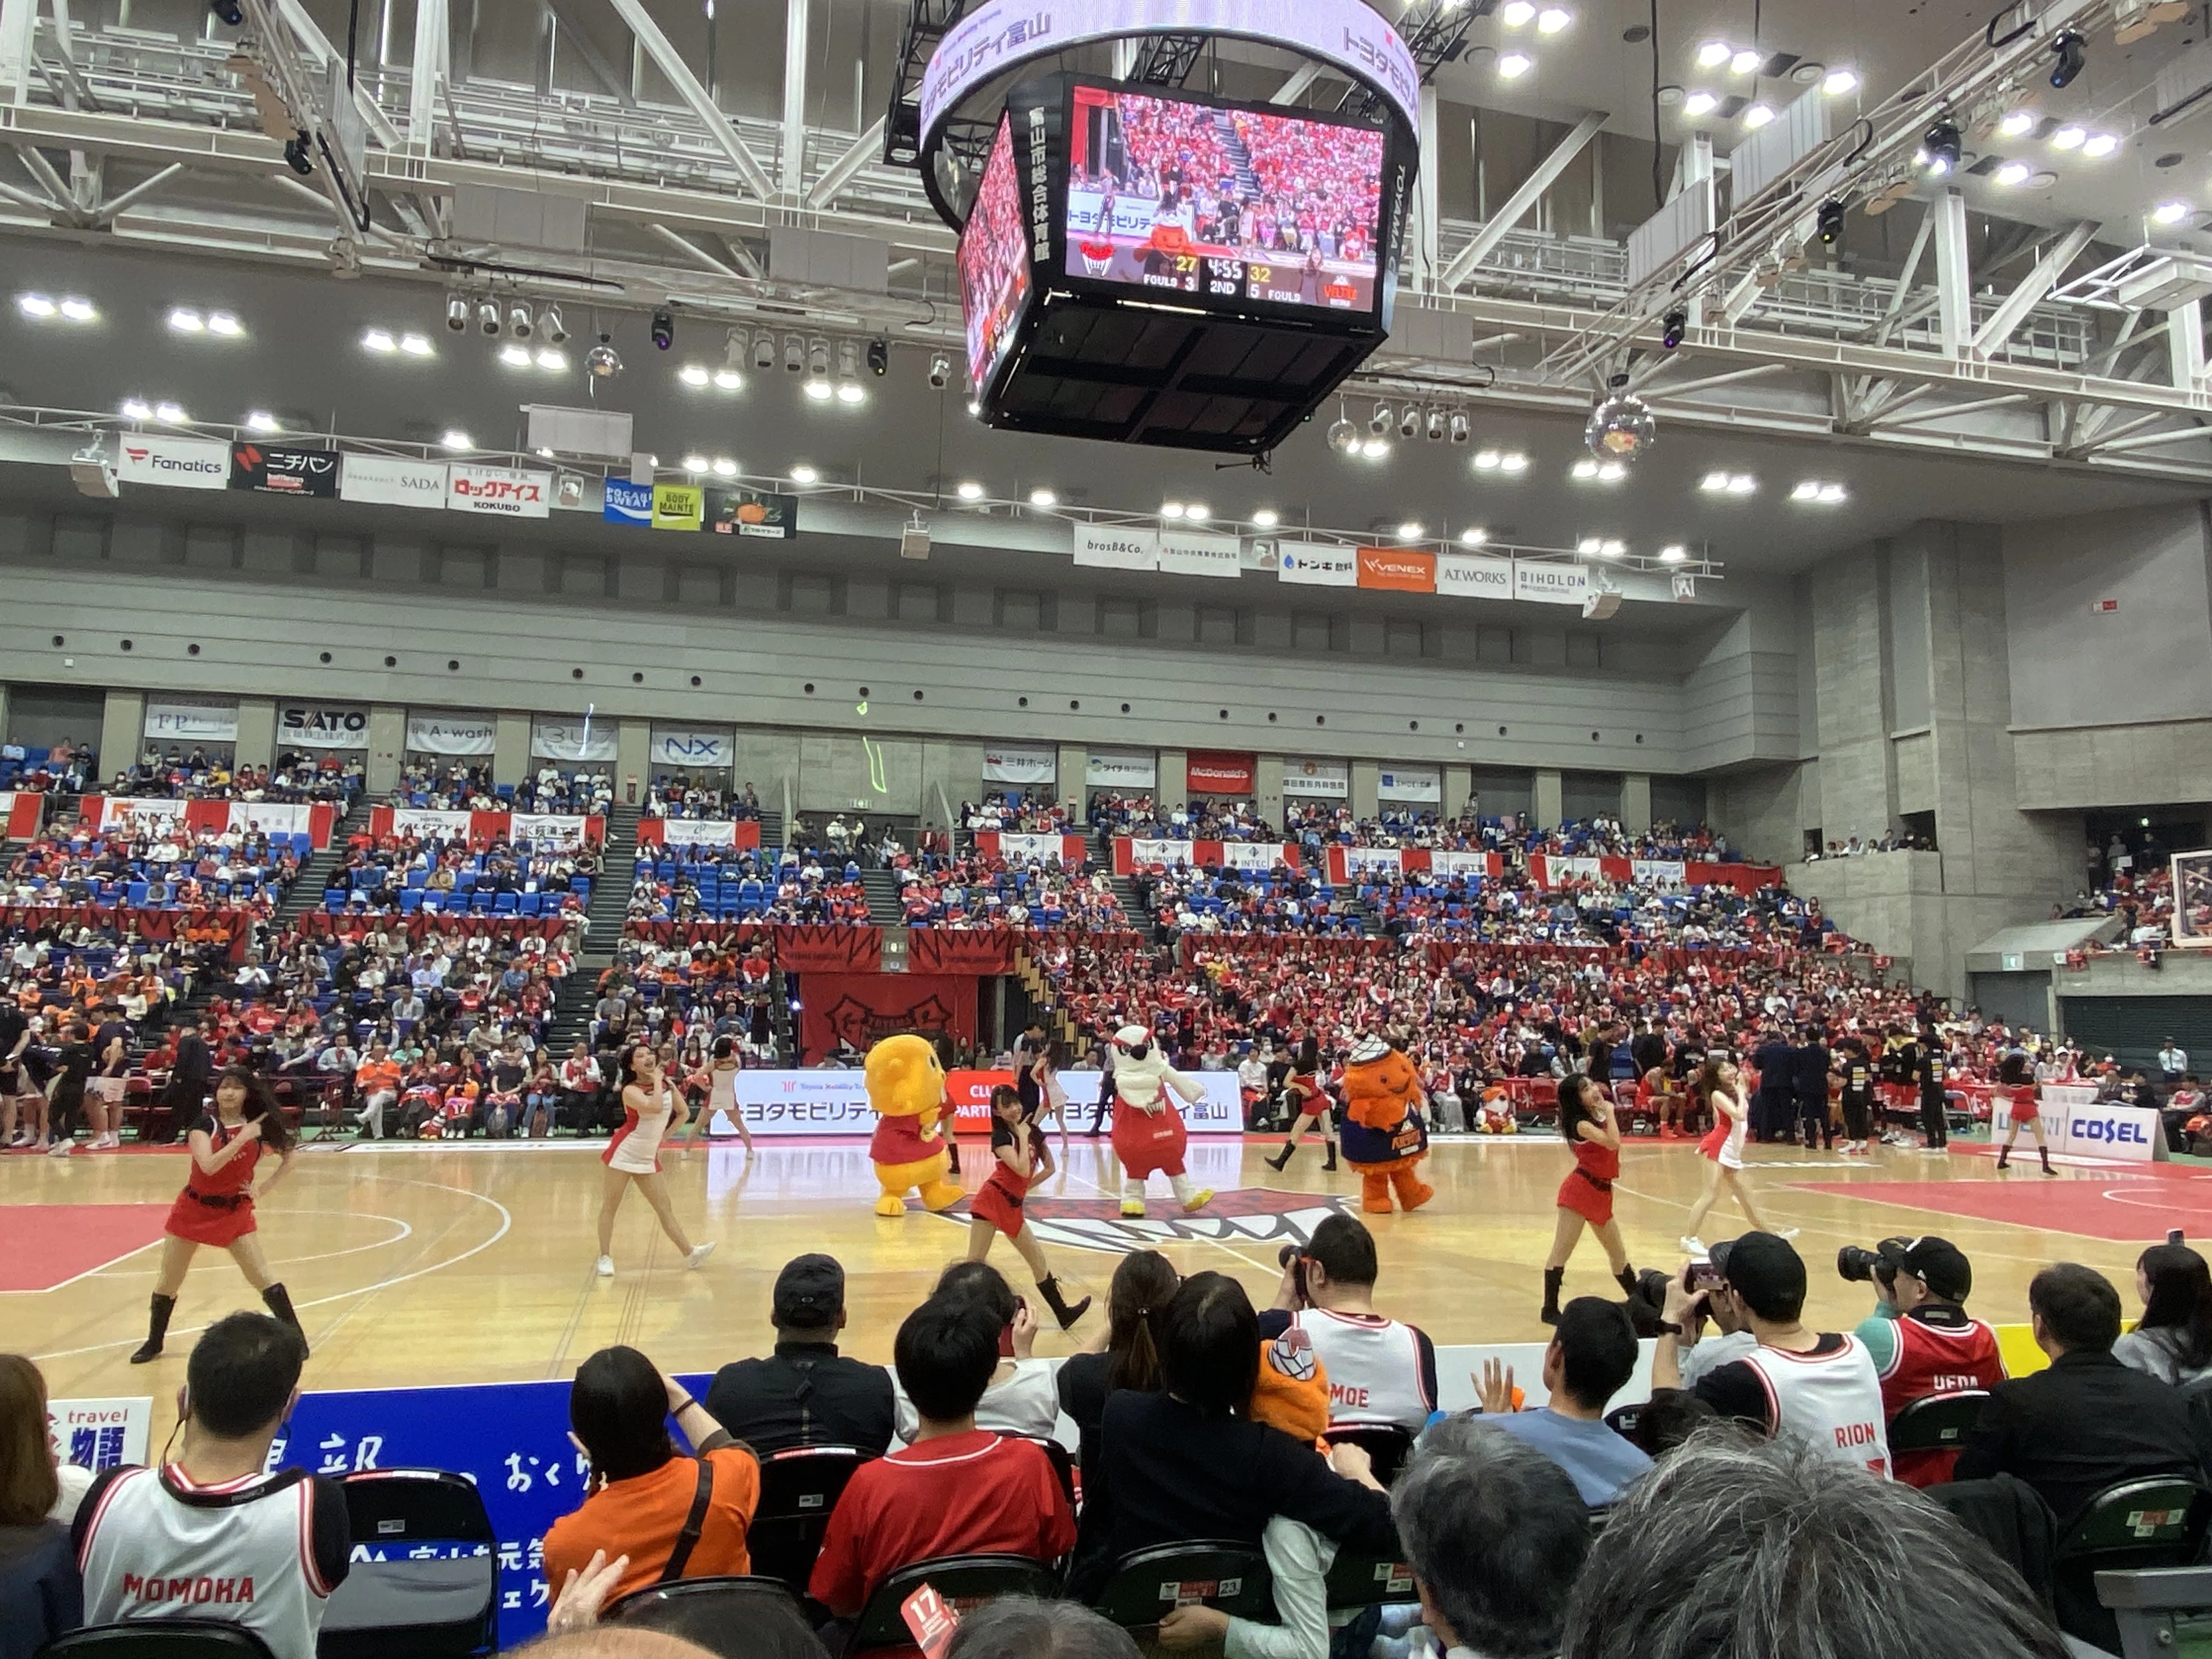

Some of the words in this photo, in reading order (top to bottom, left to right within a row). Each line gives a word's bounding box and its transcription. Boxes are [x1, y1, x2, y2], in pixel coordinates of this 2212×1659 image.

[1176, 256, 1198, 272] 27
[1208, 258, 1243, 279] 4:55
[1144, 274, 1178, 287] FOULS
[1184, 276, 1195, 291] 3
[1249, 266, 1272, 283] 32
[1210, 280, 1235, 295] 2ND
[1250, 284, 1260, 298] 5
[1268, 289, 1301, 302] FOULS
[152, 455, 222, 474] Fanatics
[266, 453, 334, 473] ニチバン
[400, 476, 439, 491] SADA
[454, 478, 541, 502] ロックアイス
[606, 496, 649, 508] SWEAT
[607, 487, 652, 501] POCARI
[666, 495, 690, 504] BODY
[473, 501, 521, 512] KOKUBO
[1087, 539, 1144, 554] brosB&Co.
[1377, 563, 1426, 574] VENEX
[283, 709, 366, 731] SATO
[1006, 757, 1052, 768] 三井ホーム
[1190, 767, 1249, 778] McDonald's
[2072, 1118, 2147, 1144] COSEL
[68, 1408, 128, 1424] travel
[1833, 1422, 1876, 1448] RION
[123, 1572, 255, 1604] MOMOKA
[910, 1588, 938, 1623] 17
